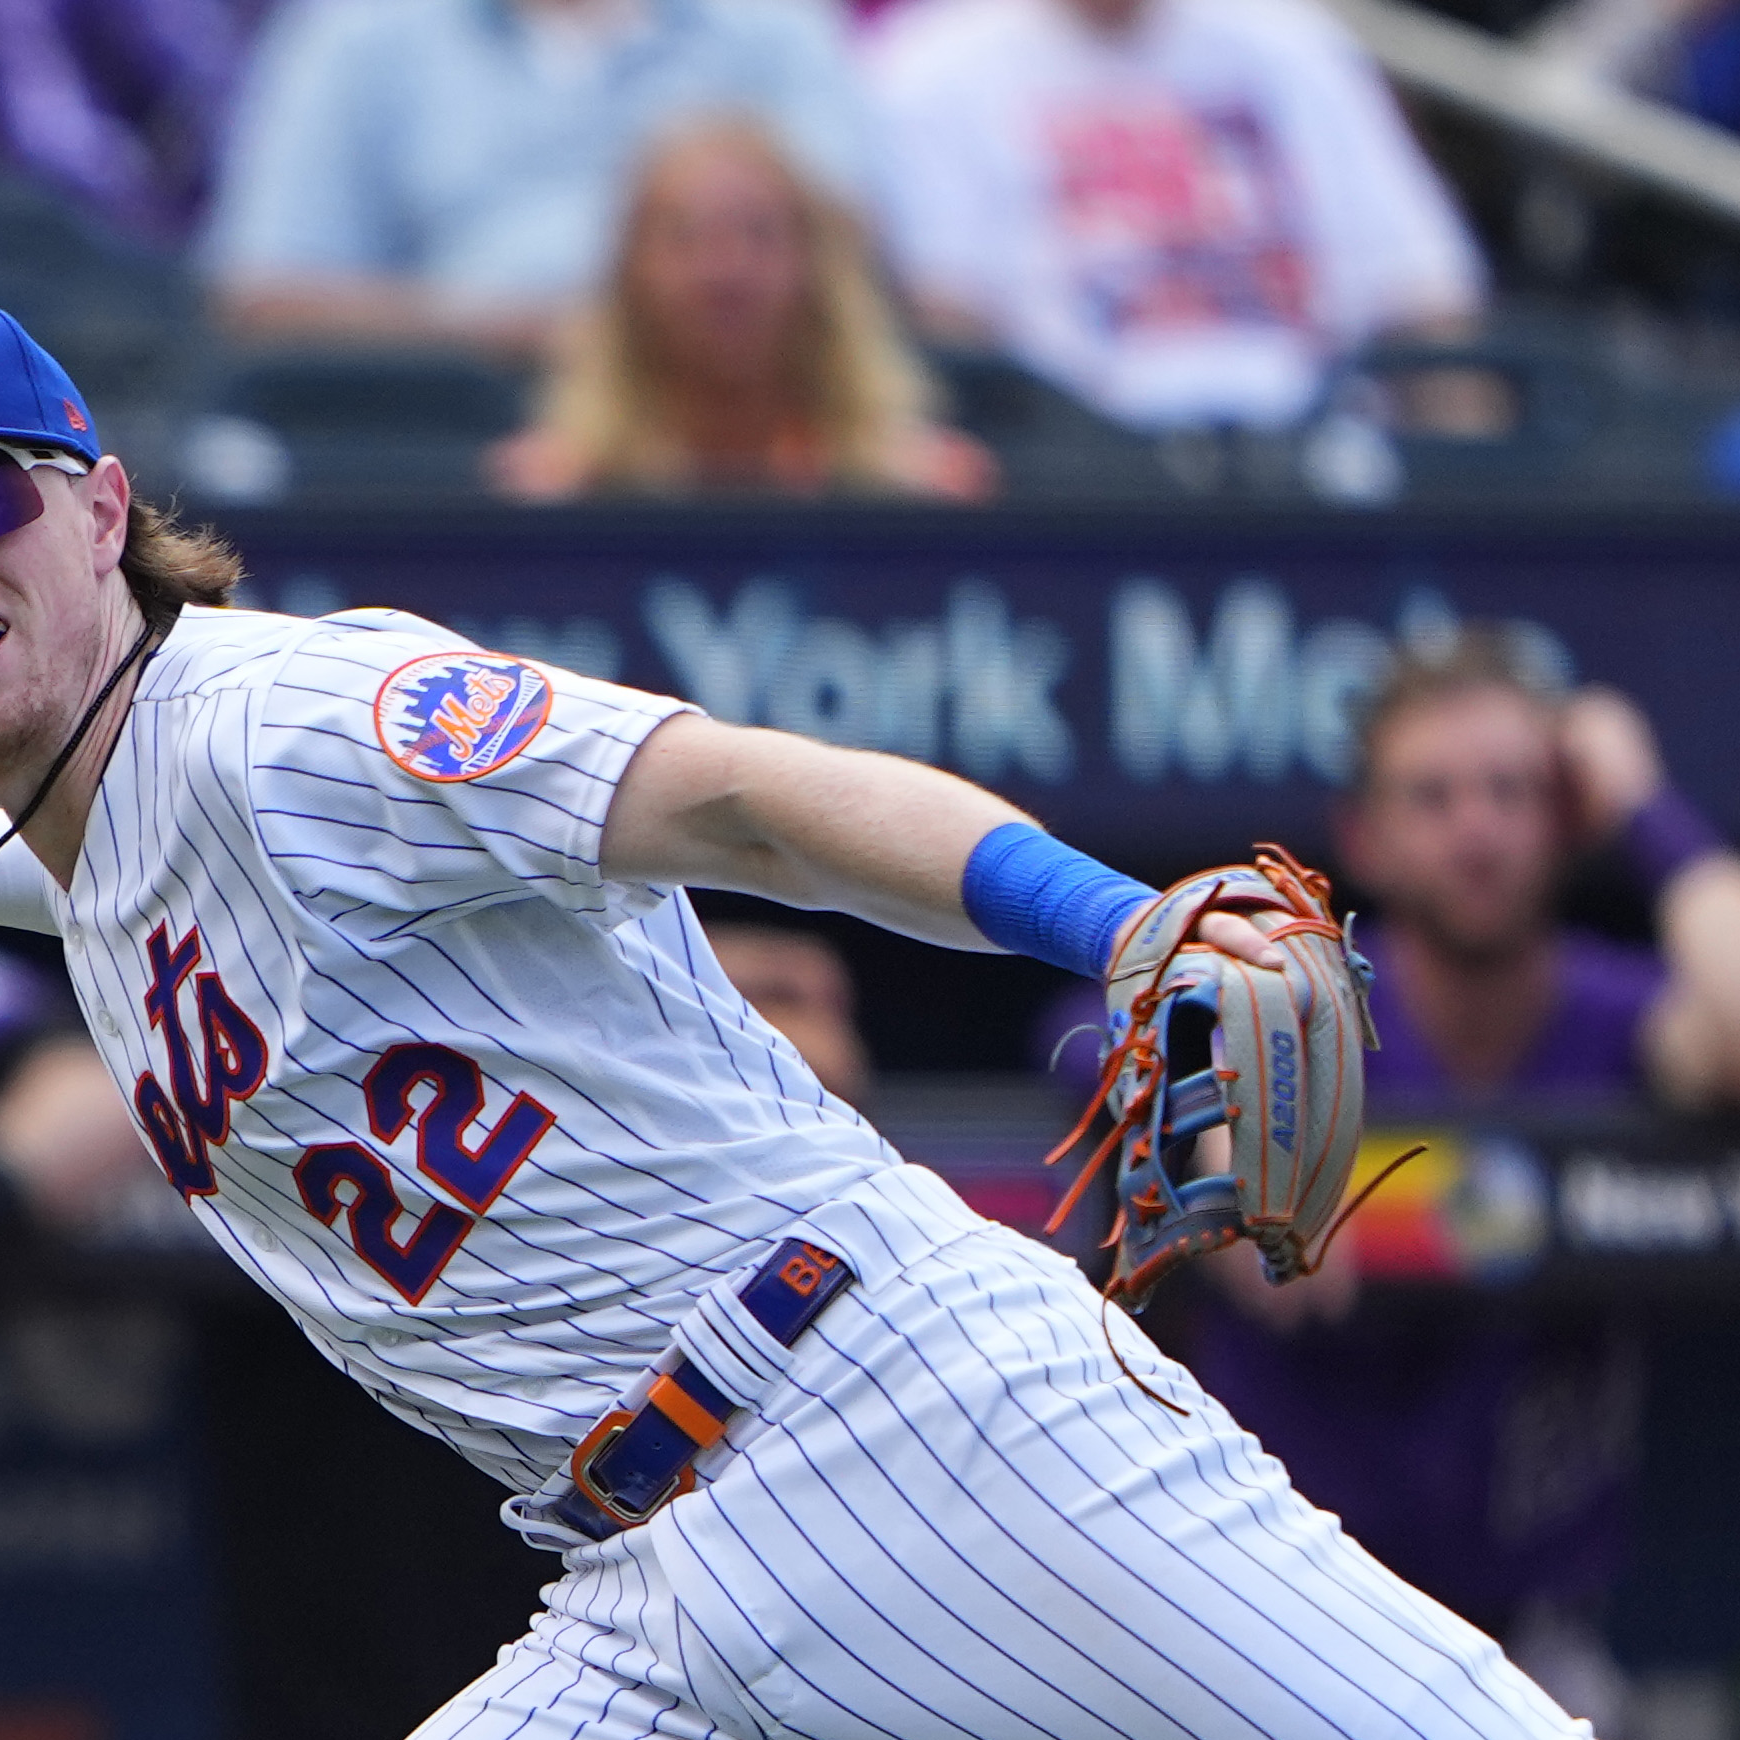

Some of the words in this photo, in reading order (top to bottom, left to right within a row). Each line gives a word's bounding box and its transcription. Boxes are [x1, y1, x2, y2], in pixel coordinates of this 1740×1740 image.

[429, 668, 517, 763] Mets
[646, 574, 1077, 786] York
[1111, 574, 1574, 788] Me
[135, 918, 268, 1207] ets
[1270, 1028, 1297, 1154] A2000
[293, 1043, 558, 1307] 22
[1562, 1150, 1721, 1253] New
